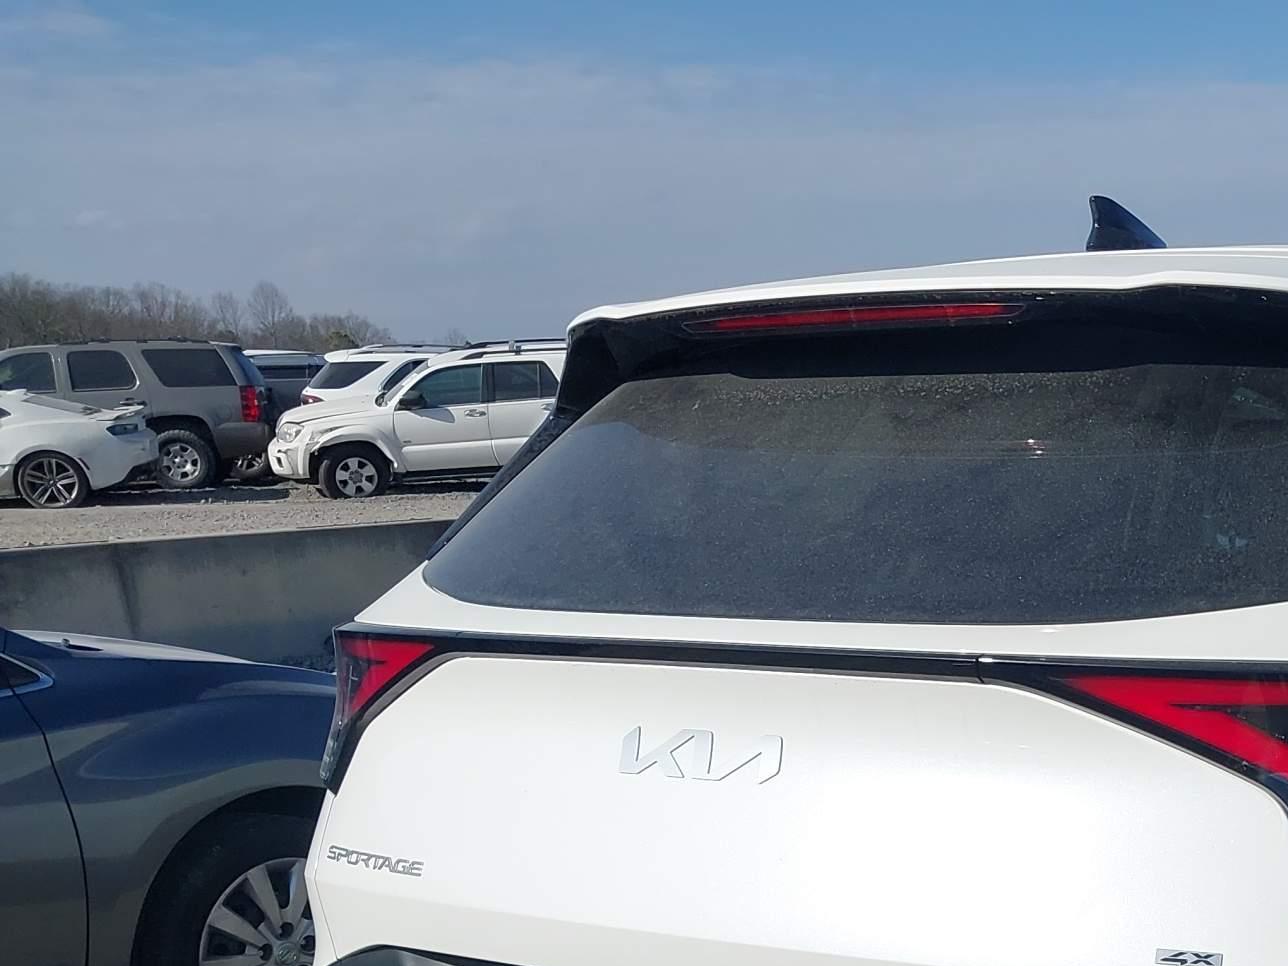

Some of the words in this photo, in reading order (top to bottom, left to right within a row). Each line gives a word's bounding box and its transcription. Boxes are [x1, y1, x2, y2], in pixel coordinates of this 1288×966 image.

[618, 726, 783, 785] KIA
[326, 844, 424, 877] SPORTAGE
[1159, 951, 1216, 966] 4X
